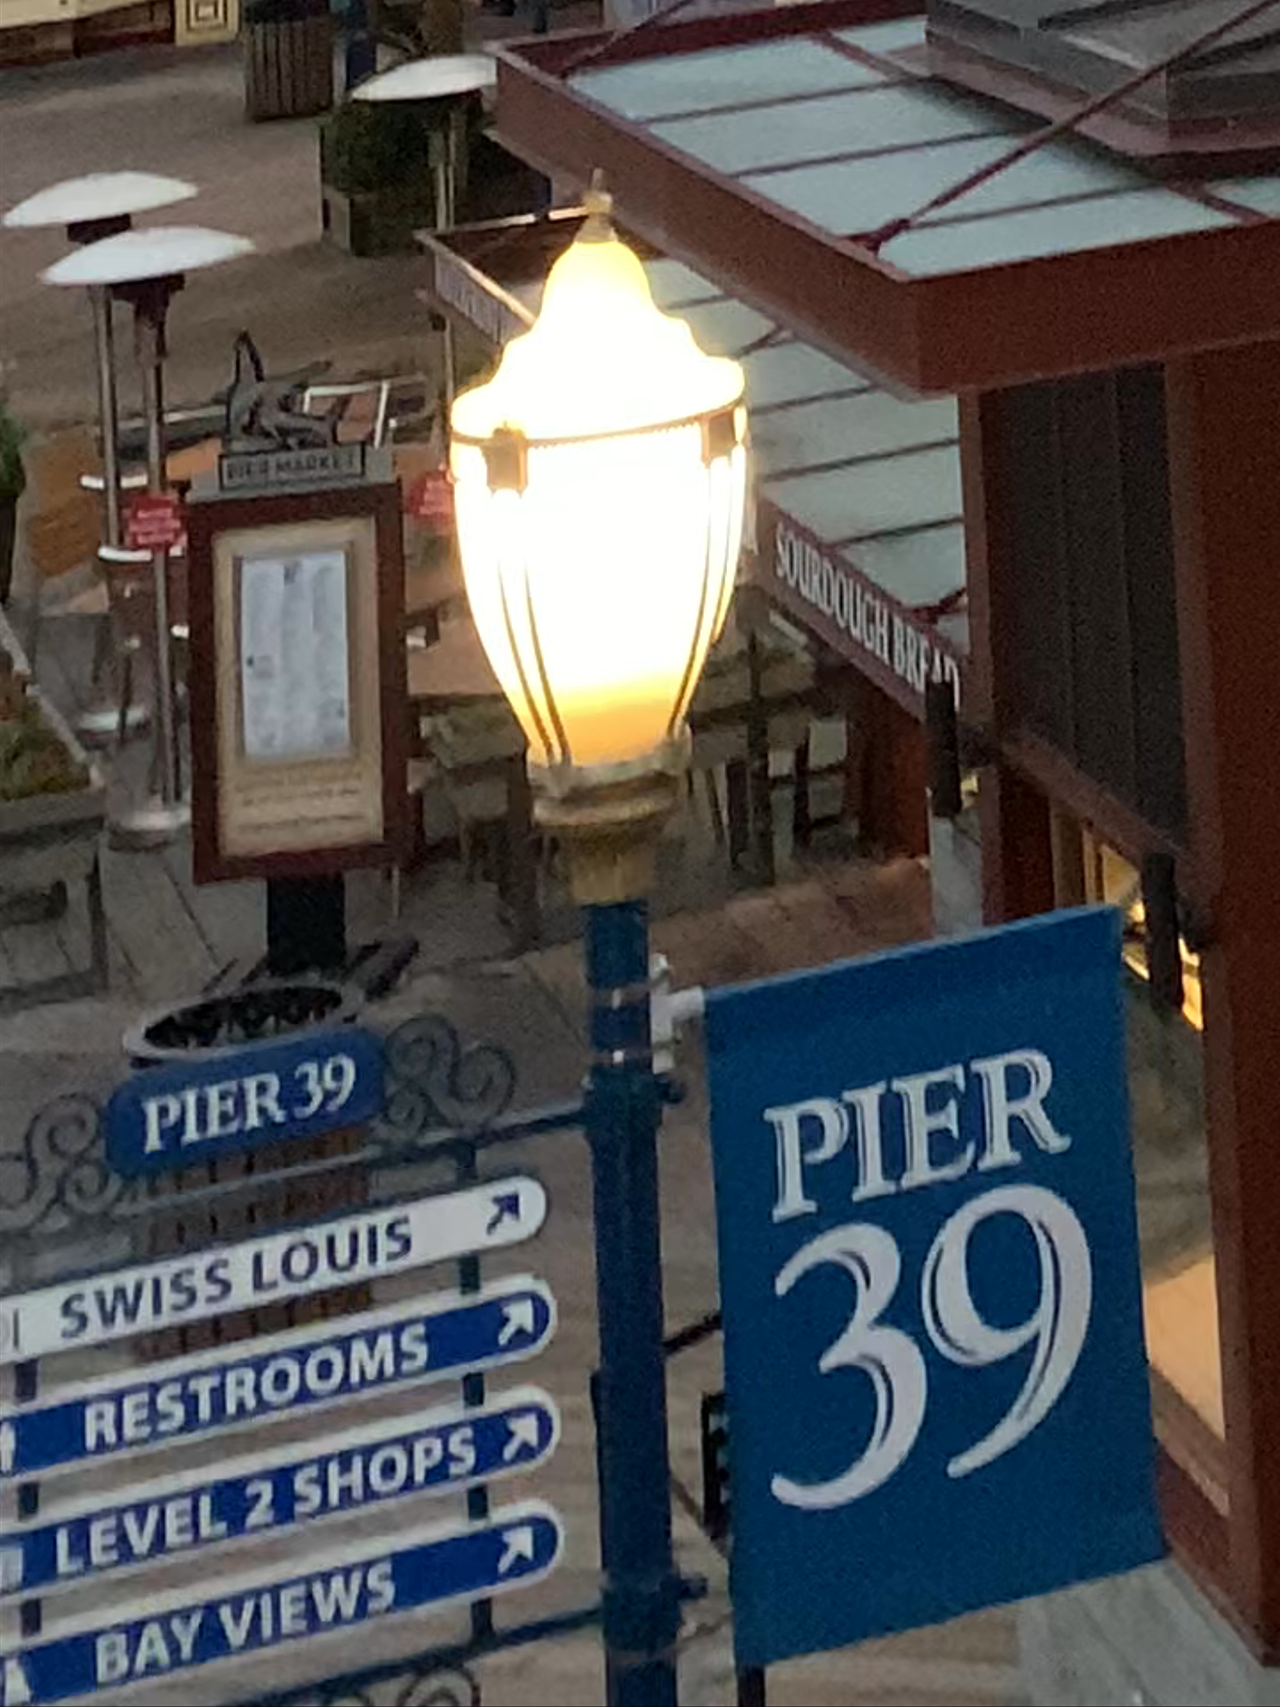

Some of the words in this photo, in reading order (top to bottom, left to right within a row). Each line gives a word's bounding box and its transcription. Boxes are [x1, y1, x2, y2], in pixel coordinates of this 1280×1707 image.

[776, 521, 890, 667] SOURDOUGH
[142, 1071, 289, 1155] PIER
[295, 1053, 357, 1114] 39
[762, 1047, 1073, 1223] PIER
[59, 1254, 233, 1340] SWISS
[252, 1216, 413, 1292] LOUIS
[770, 1183, 1093, 1510] 39
[84, 1323, 430, 1452] RESTROOMS
[56, 1494, 228, 1575] LEVEL
[244, 1483, 278, 1530] 2
[294, 1426, 478, 1515] SHOPS
[96, 1613, 202, 1683] BAY
[219, 1565, 397, 1640] VIEWS
